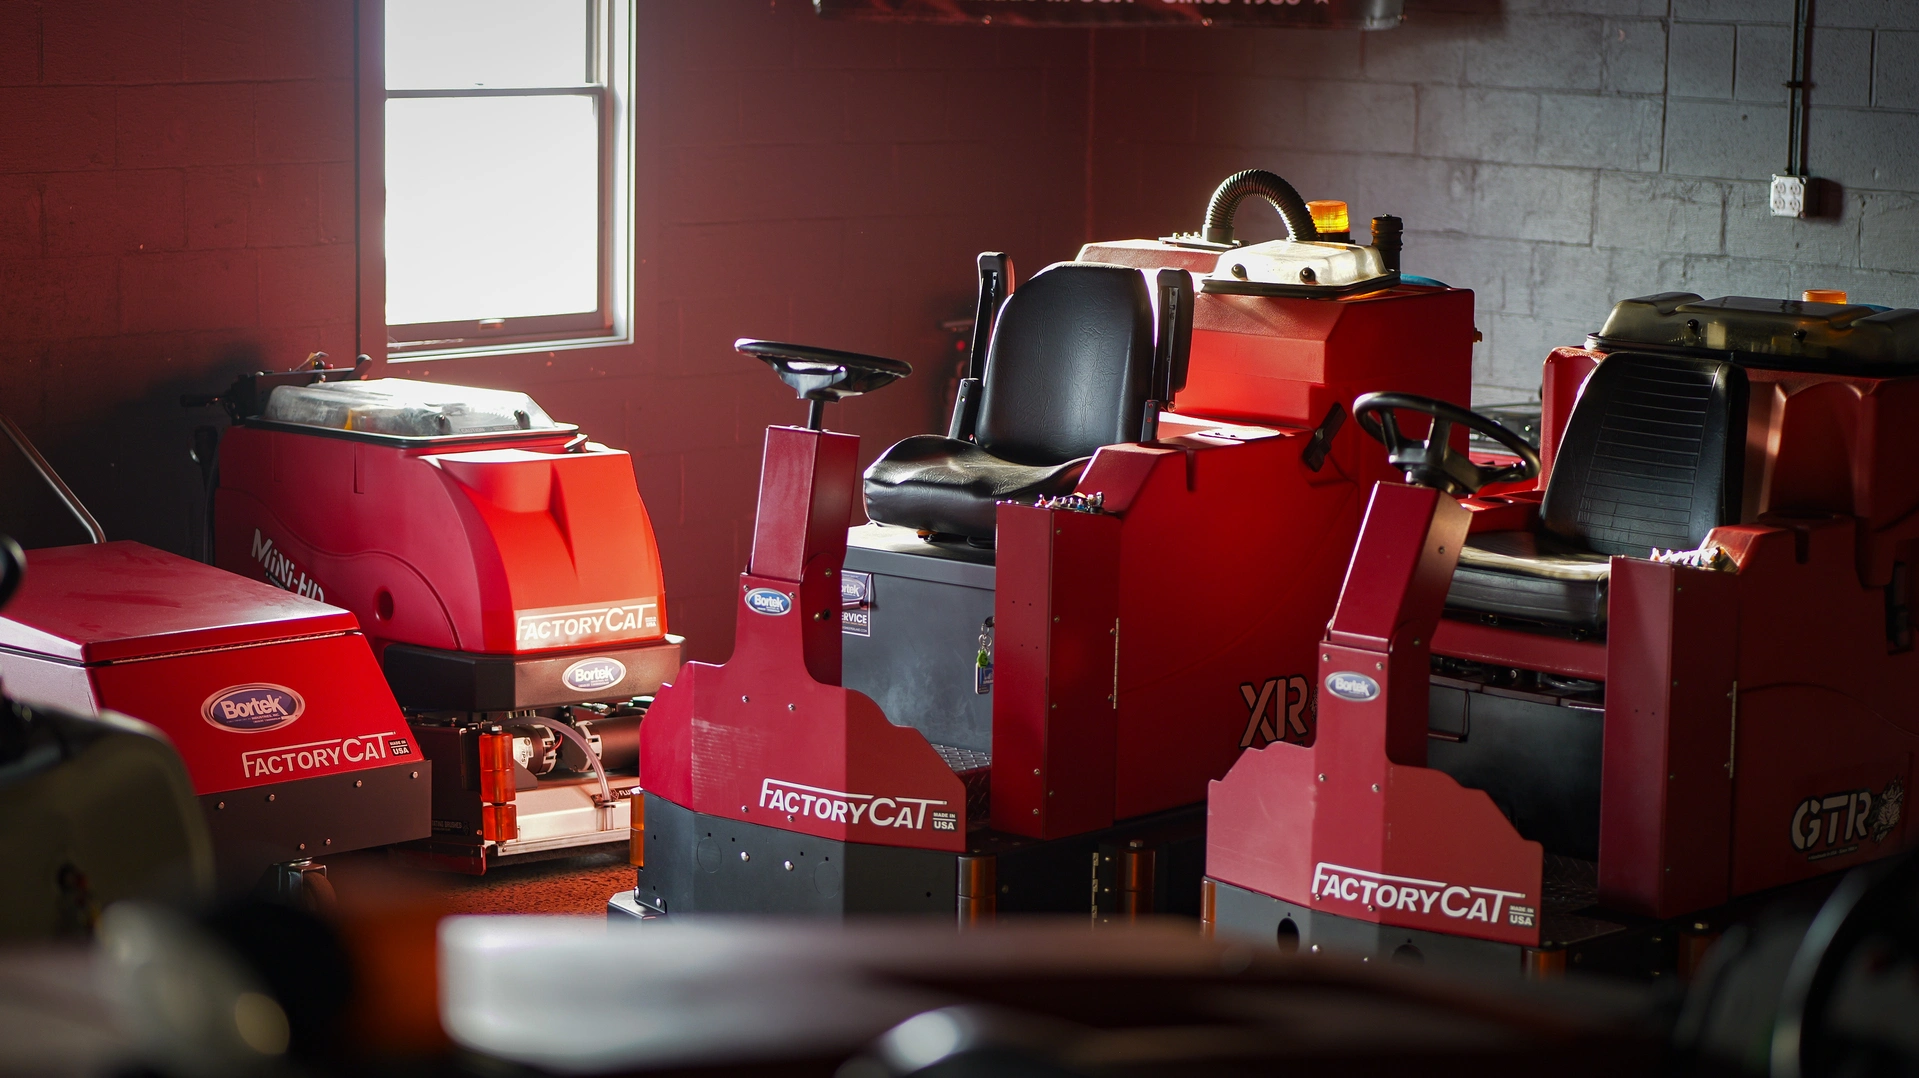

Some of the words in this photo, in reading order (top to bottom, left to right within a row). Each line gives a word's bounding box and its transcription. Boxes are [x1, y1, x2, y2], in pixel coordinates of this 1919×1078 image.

[754, 594, 785, 611] Bortek
[575, 665, 615, 682] Bortek
[1335, 677, 1370, 696] Bortek
[220, 694, 289, 720] Bortek
[1239, 676, 1308, 748] XR
[392, 747, 410, 755] USA
[934, 820, 955, 831] USA
[1791, 791, 1872, 850] GTR
[1510, 915, 1533, 926] USA
